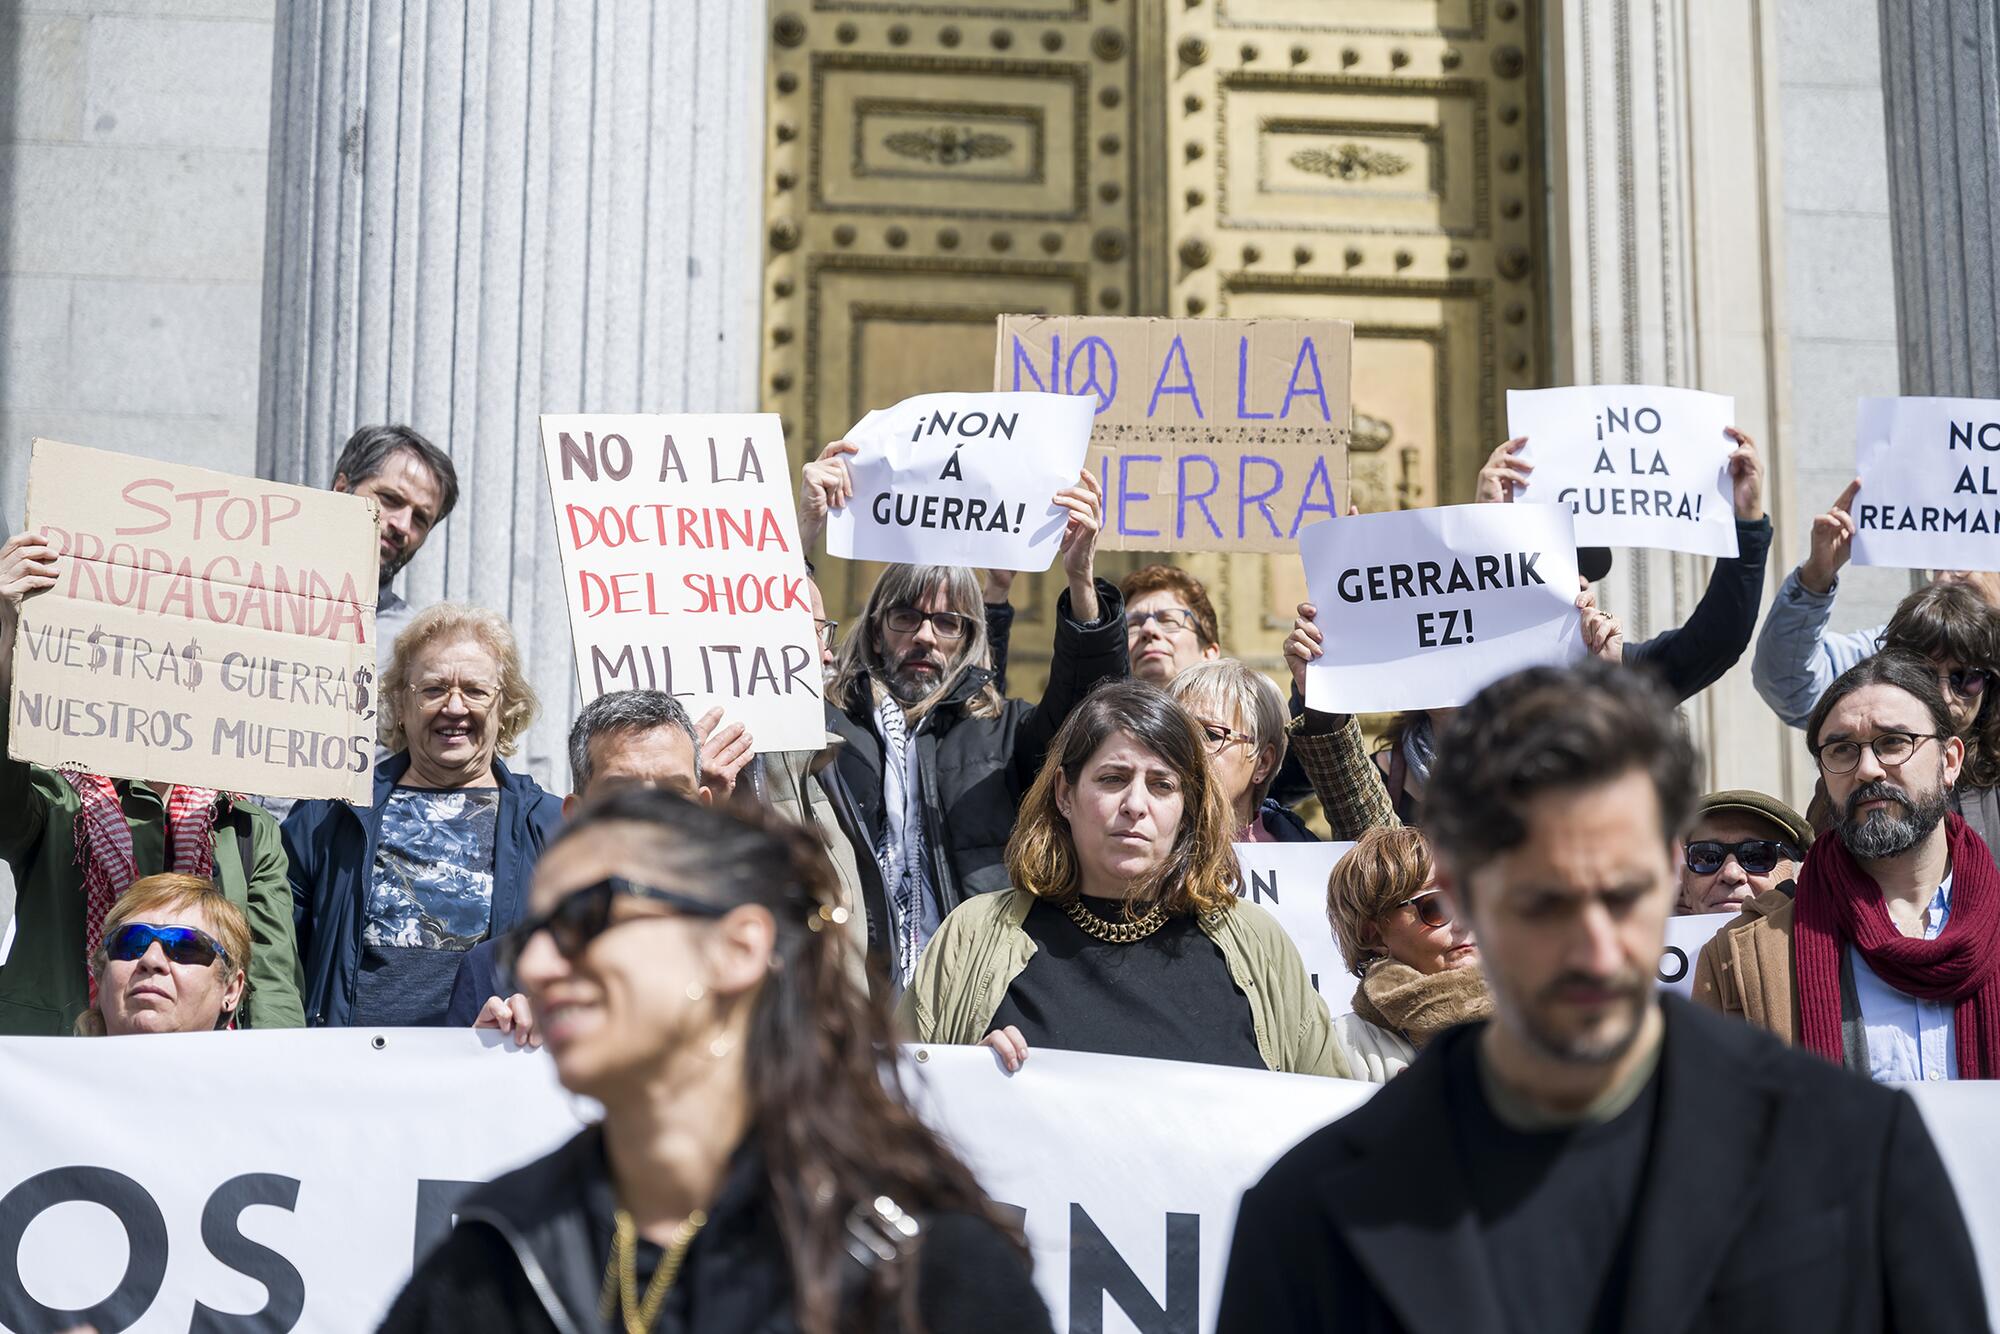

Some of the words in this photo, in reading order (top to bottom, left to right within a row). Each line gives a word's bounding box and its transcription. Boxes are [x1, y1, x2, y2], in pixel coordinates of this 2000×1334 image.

[1147, 333, 1204, 419] A
[1237, 336, 1332, 422] LA
[911, 409, 1020, 442] ¡NON
[1596, 406, 1662, 440] ¡NO
[1949, 421, 2000, 452] NO
[558, 431, 633, 482] NO
[658, 434, 688, 483] A
[707, 437, 765, 483] LA
[939, 443, 965, 481] Á
[1593, 447, 1616, 474] A
[1630, 448, 1670, 476] LA
[1953, 465, 1998, 495] AL
[115, 478, 301, 546] STOP
[565, 503, 790, 552] DOCTRINA
[872, 492, 1026, 534] GUERRA!
[1860, 505, 2000, 534] REARMA
[579, 570, 670, 618] DEL
[682, 572, 811, 615] SHOCK
[1337, 552, 1546, 603] GERRARIK
[1416, 609, 1475, 648] EZ!
[591, 644, 820, 699] MILITAR
[17, 690, 193, 751] NUESTROS
[212, 717, 370, 773] MUERTOS
